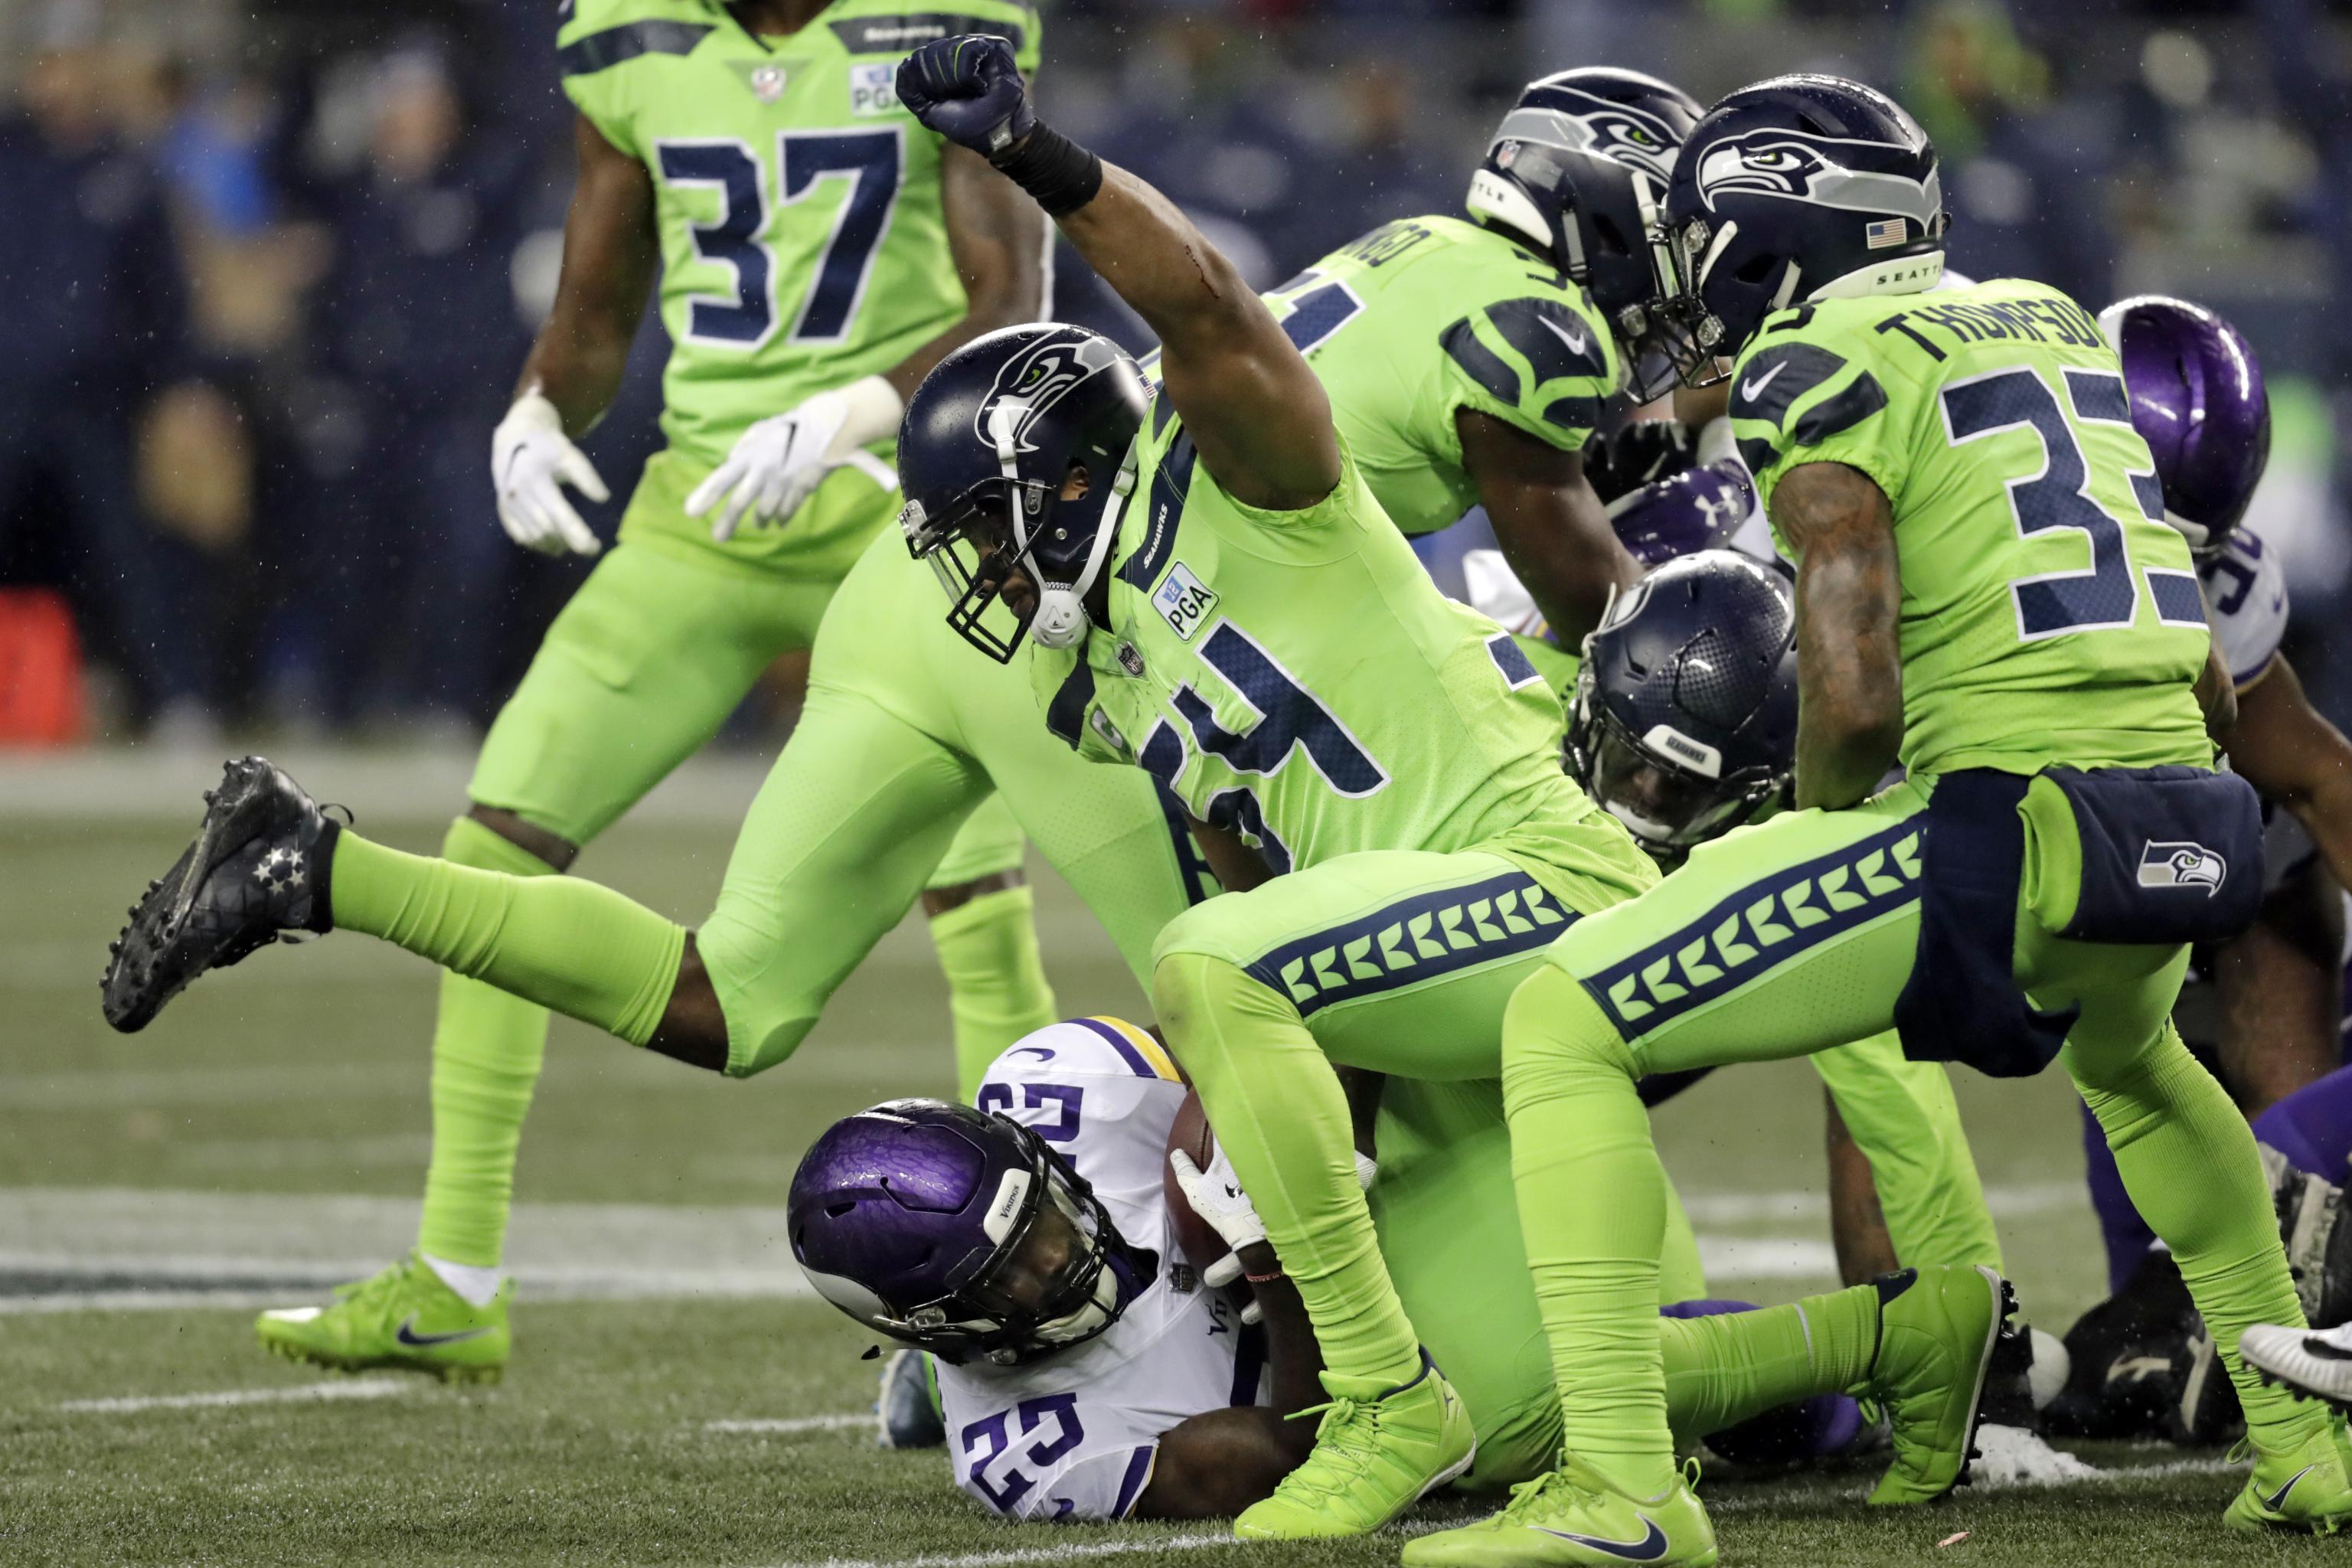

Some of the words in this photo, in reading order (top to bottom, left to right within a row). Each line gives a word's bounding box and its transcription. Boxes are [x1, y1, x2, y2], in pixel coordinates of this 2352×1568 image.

[655, 124, 905, 352] 37
[1144, 503, 1168, 569] SEAHAWKS
[1168, 586, 1213, 634] PGA
[999, 1184, 1020, 1218] VIKINGS
